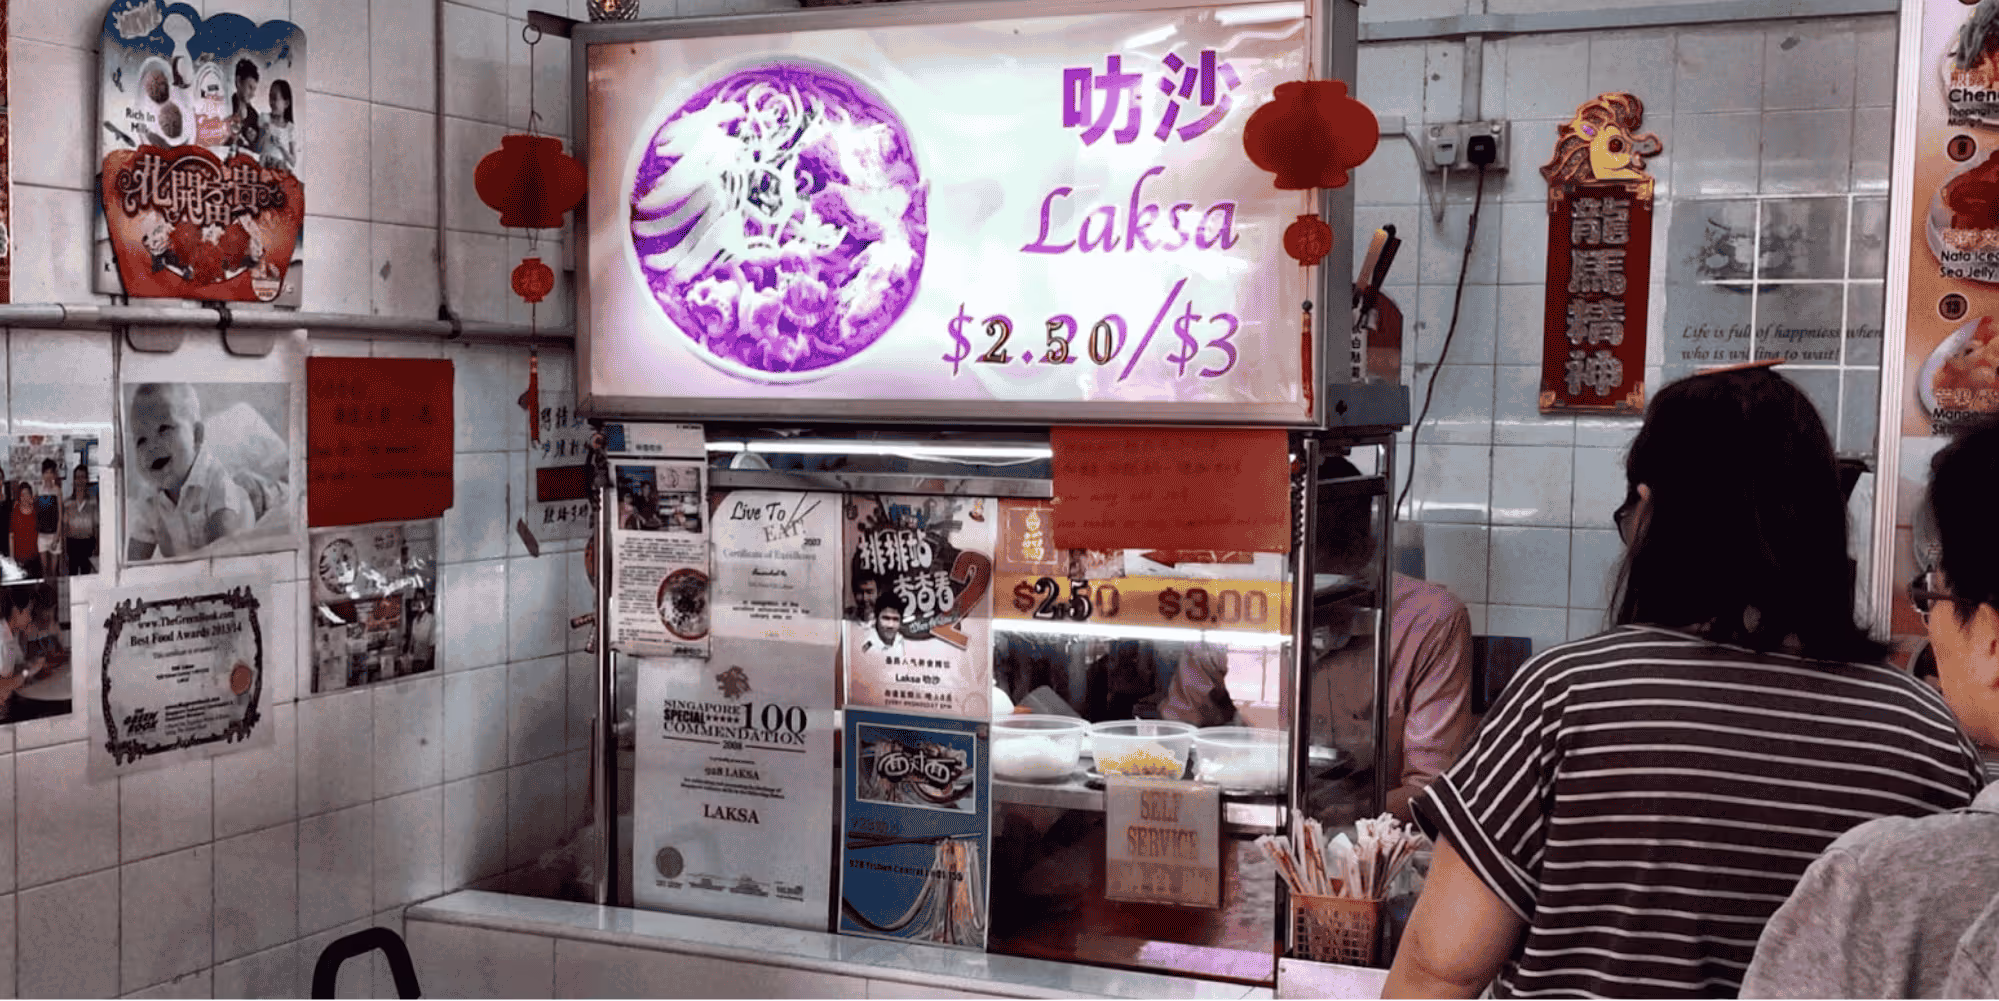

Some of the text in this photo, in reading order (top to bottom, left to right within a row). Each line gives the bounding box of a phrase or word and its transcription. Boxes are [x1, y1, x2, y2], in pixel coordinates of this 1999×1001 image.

[1062, 50, 1241, 147] 叻沙
[1948, 88, 1999, 103] Chen
[125, 107, 145, 120] Rich
[1019, 166, 1239, 255] Laksa
[1941, 251, 1971, 262] Nata
[1940, 267, 1995, 280] Sea Jelly
[1564, 197, 1630, 396] 龍馬精神
[1682, 323, 1710, 342] Life
[1714, 326, 1725, 339] is
[1727, 323, 1751, 342] full
[1756, 323, 1771, 342] of
[1847, 323, 1884, 339] when
[1682, 347, 1709, 361] who
[1713, 348, 1725, 361] is
[1784, 347, 1799, 361] to
[730, 501, 786, 521] Live To
[859, 530, 933, 575] 排排站
[893, 571, 954, 623] 查查看
[930, 550, 992, 651] 2
[1013, 576, 1268, 625] $2.50 $3.00
[130, 634, 150, 647] Best
[152, 631, 174, 645] Food
[176, 626, 210, 641] Awards
[895, 673, 921, 684] Laksa
[664, 700, 741, 716] SINGAPORE
[664, 709, 706, 724] SPECIAL
[741, 702, 808, 735] 100
[663, 722, 807, 745] COMMENDATION
[725, 768, 760, 781] LAKSA
[703, 804, 760, 824] LAKSA
[1141, 790, 1184, 822] SELF
[1128, 825, 1199, 861] SERVICE
[849, 859, 864, 868] 928
